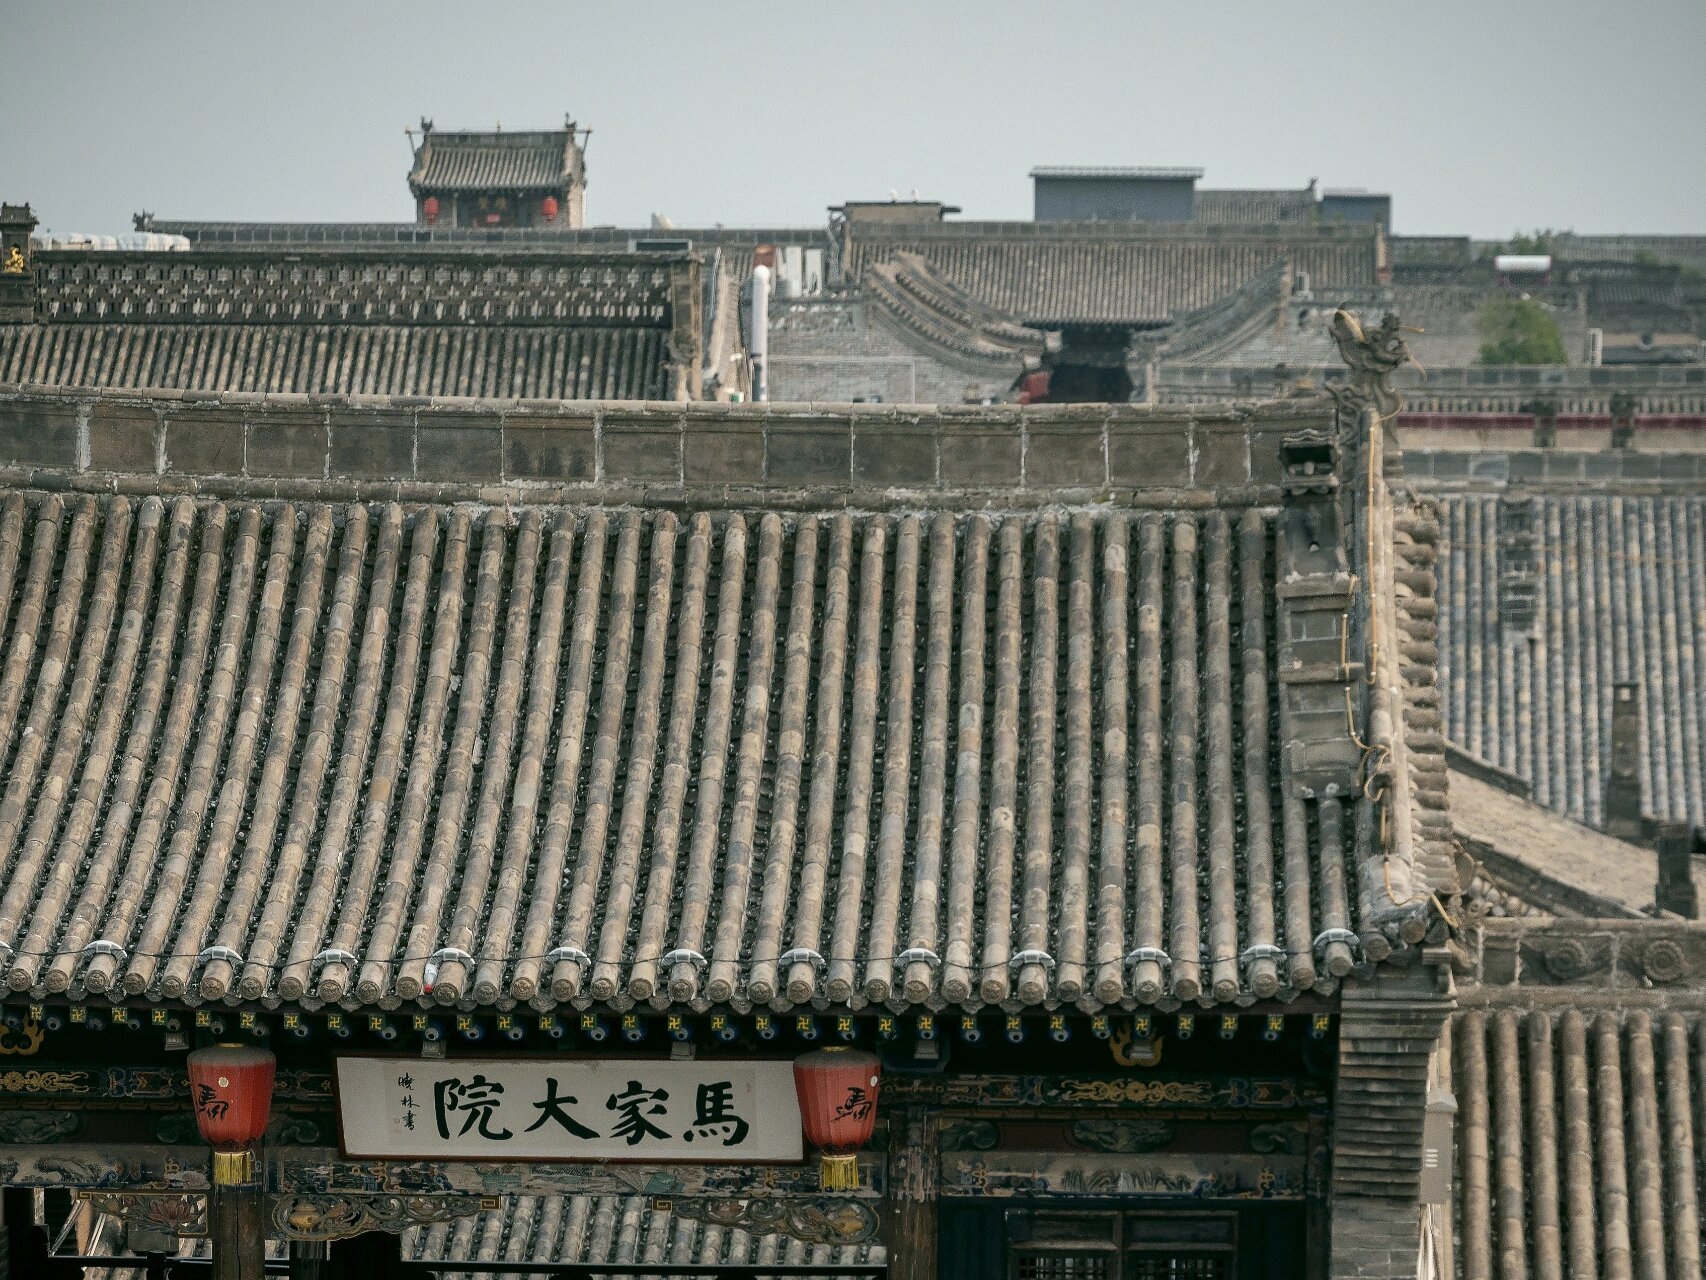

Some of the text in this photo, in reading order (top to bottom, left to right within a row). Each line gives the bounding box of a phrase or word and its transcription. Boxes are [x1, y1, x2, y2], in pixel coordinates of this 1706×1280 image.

[433, 1074, 750, 1147] 馬家大院
[830, 1086, 873, 1124] 馬
